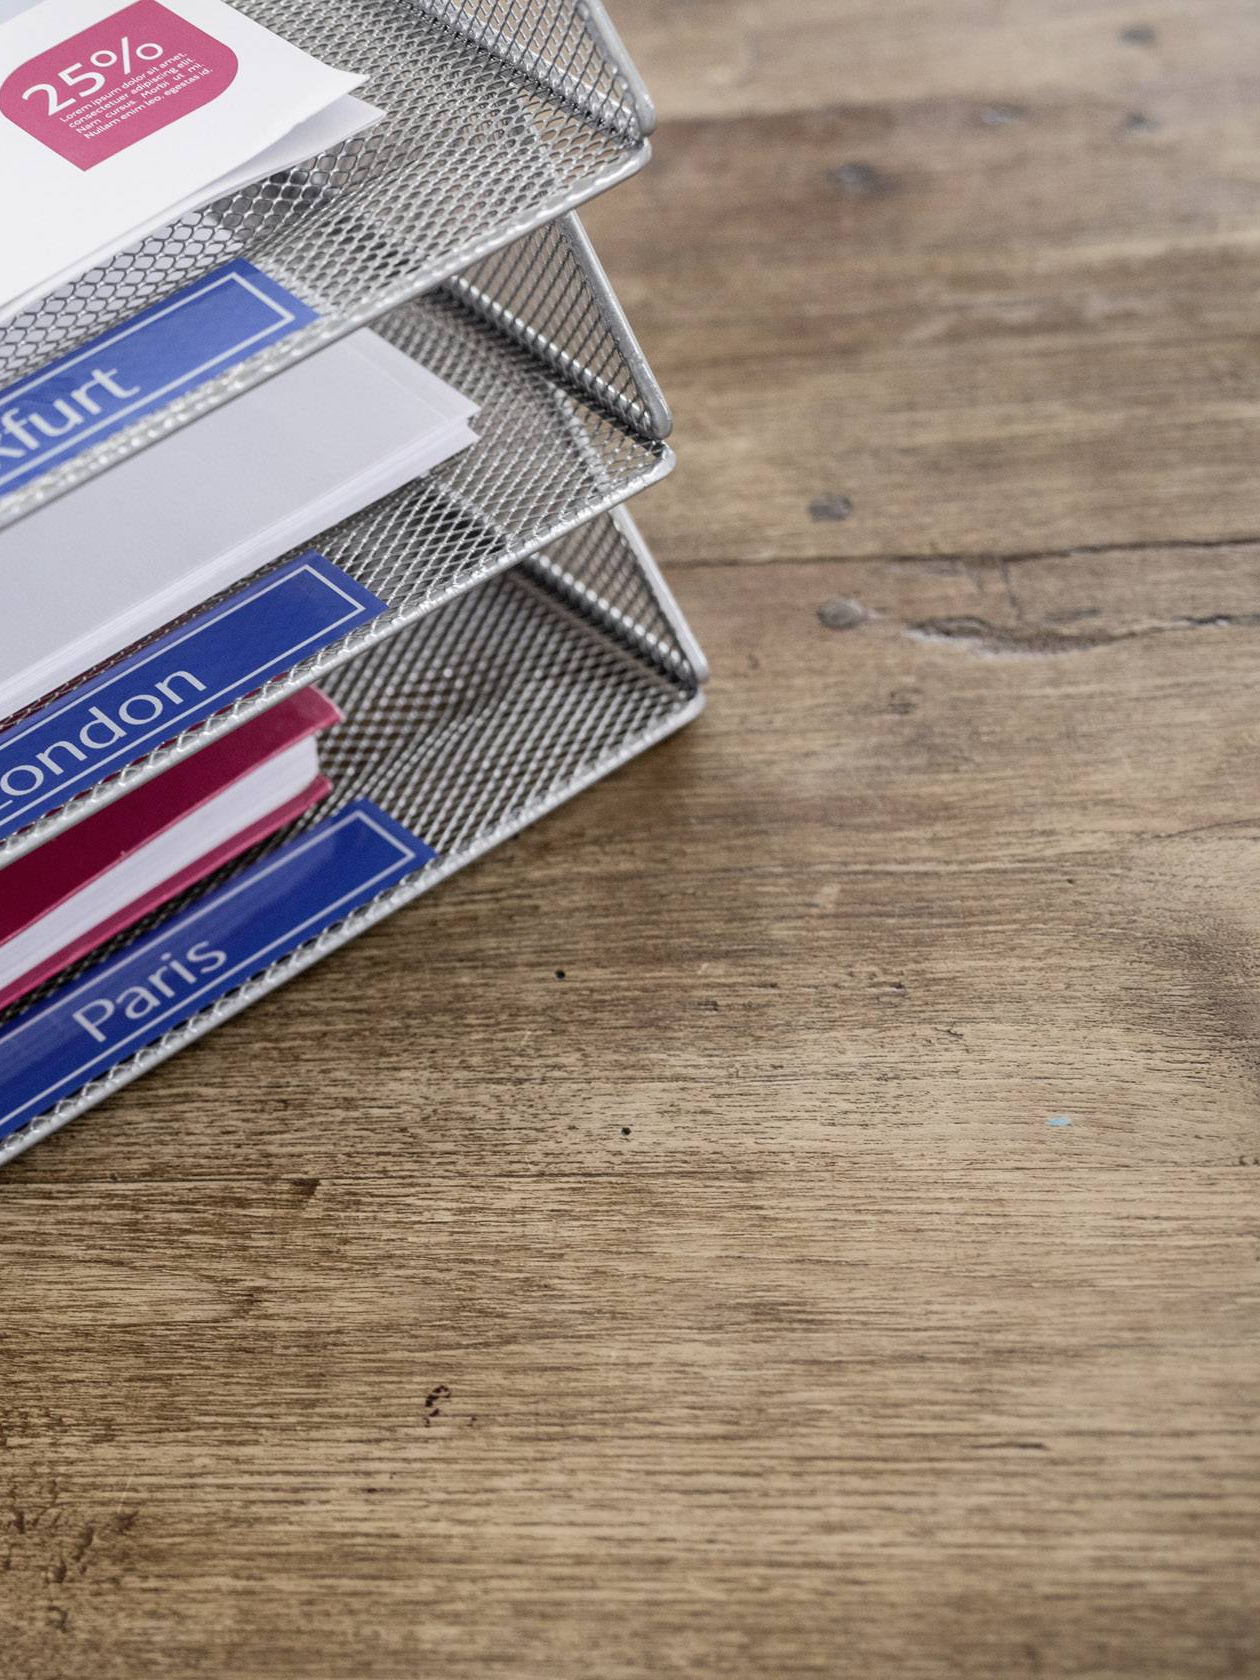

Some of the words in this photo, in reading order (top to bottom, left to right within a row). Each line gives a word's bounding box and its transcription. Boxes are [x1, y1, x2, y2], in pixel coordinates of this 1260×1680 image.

[21, 36, 164, 117] 25%
[59, 103, 93, 123] Lorem
[90, 87, 122, 106] ipsum
[121, 73, 147, 89] dolor
[146, 66, 160, 76] sit
[68, 93, 129, 129] consectetuer
[130, 67, 179, 95] adipiscing
[75, 118, 102, 134] Nam
[140, 80, 170, 99] Morbi
[172, 72, 185, 81] ut
[83, 118, 121, 140] Nullam
[120, 104, 147, 120] enim
[163, 74, 201, 96] egestas
[72, 940, 227, 1043] Paris
